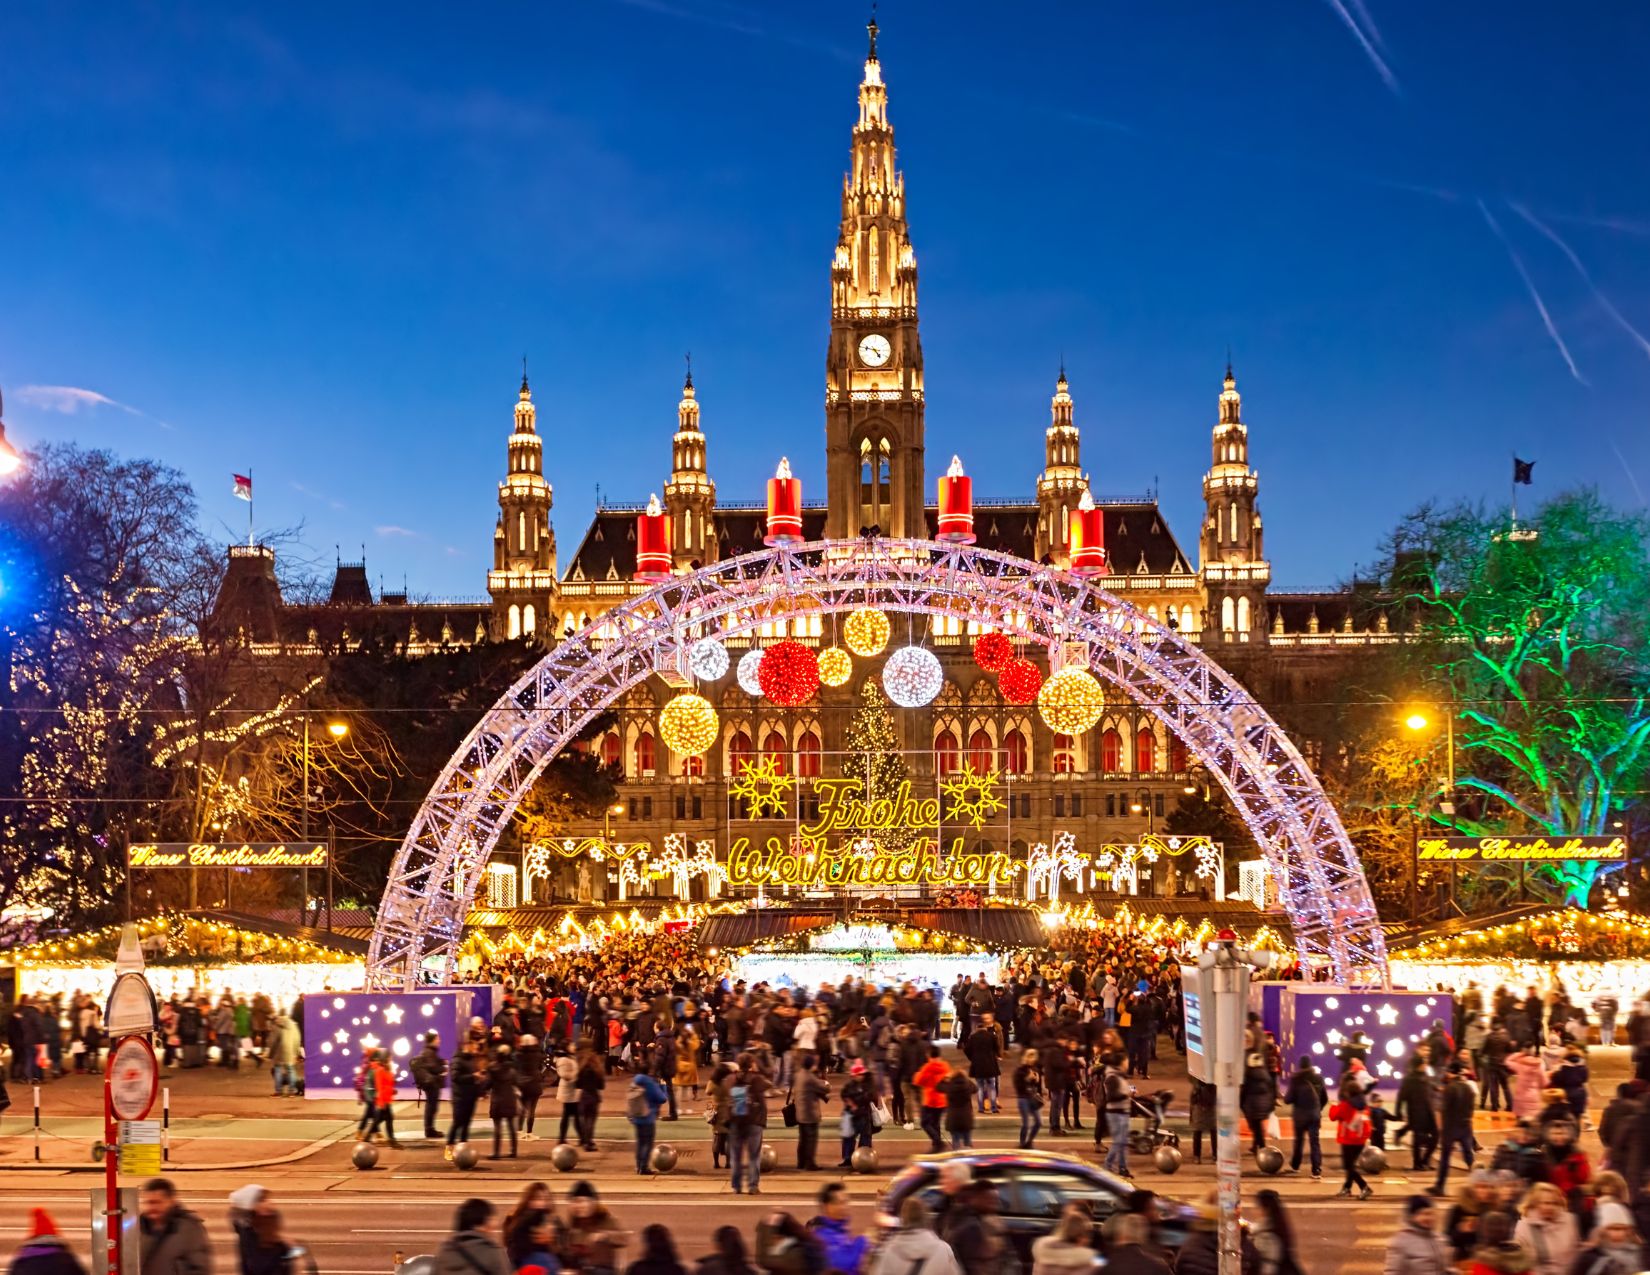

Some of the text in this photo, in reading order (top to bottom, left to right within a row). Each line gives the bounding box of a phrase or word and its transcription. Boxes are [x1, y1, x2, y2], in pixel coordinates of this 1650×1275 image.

[800, 778, 941, 838] Frohe
[129, 844, 328, 866] Wiener Christkindlmarkt
[727, 837, 1011, 886] Weihnachten
[1418, 837, 1626, 859] Wiener Christkindlmarkt
